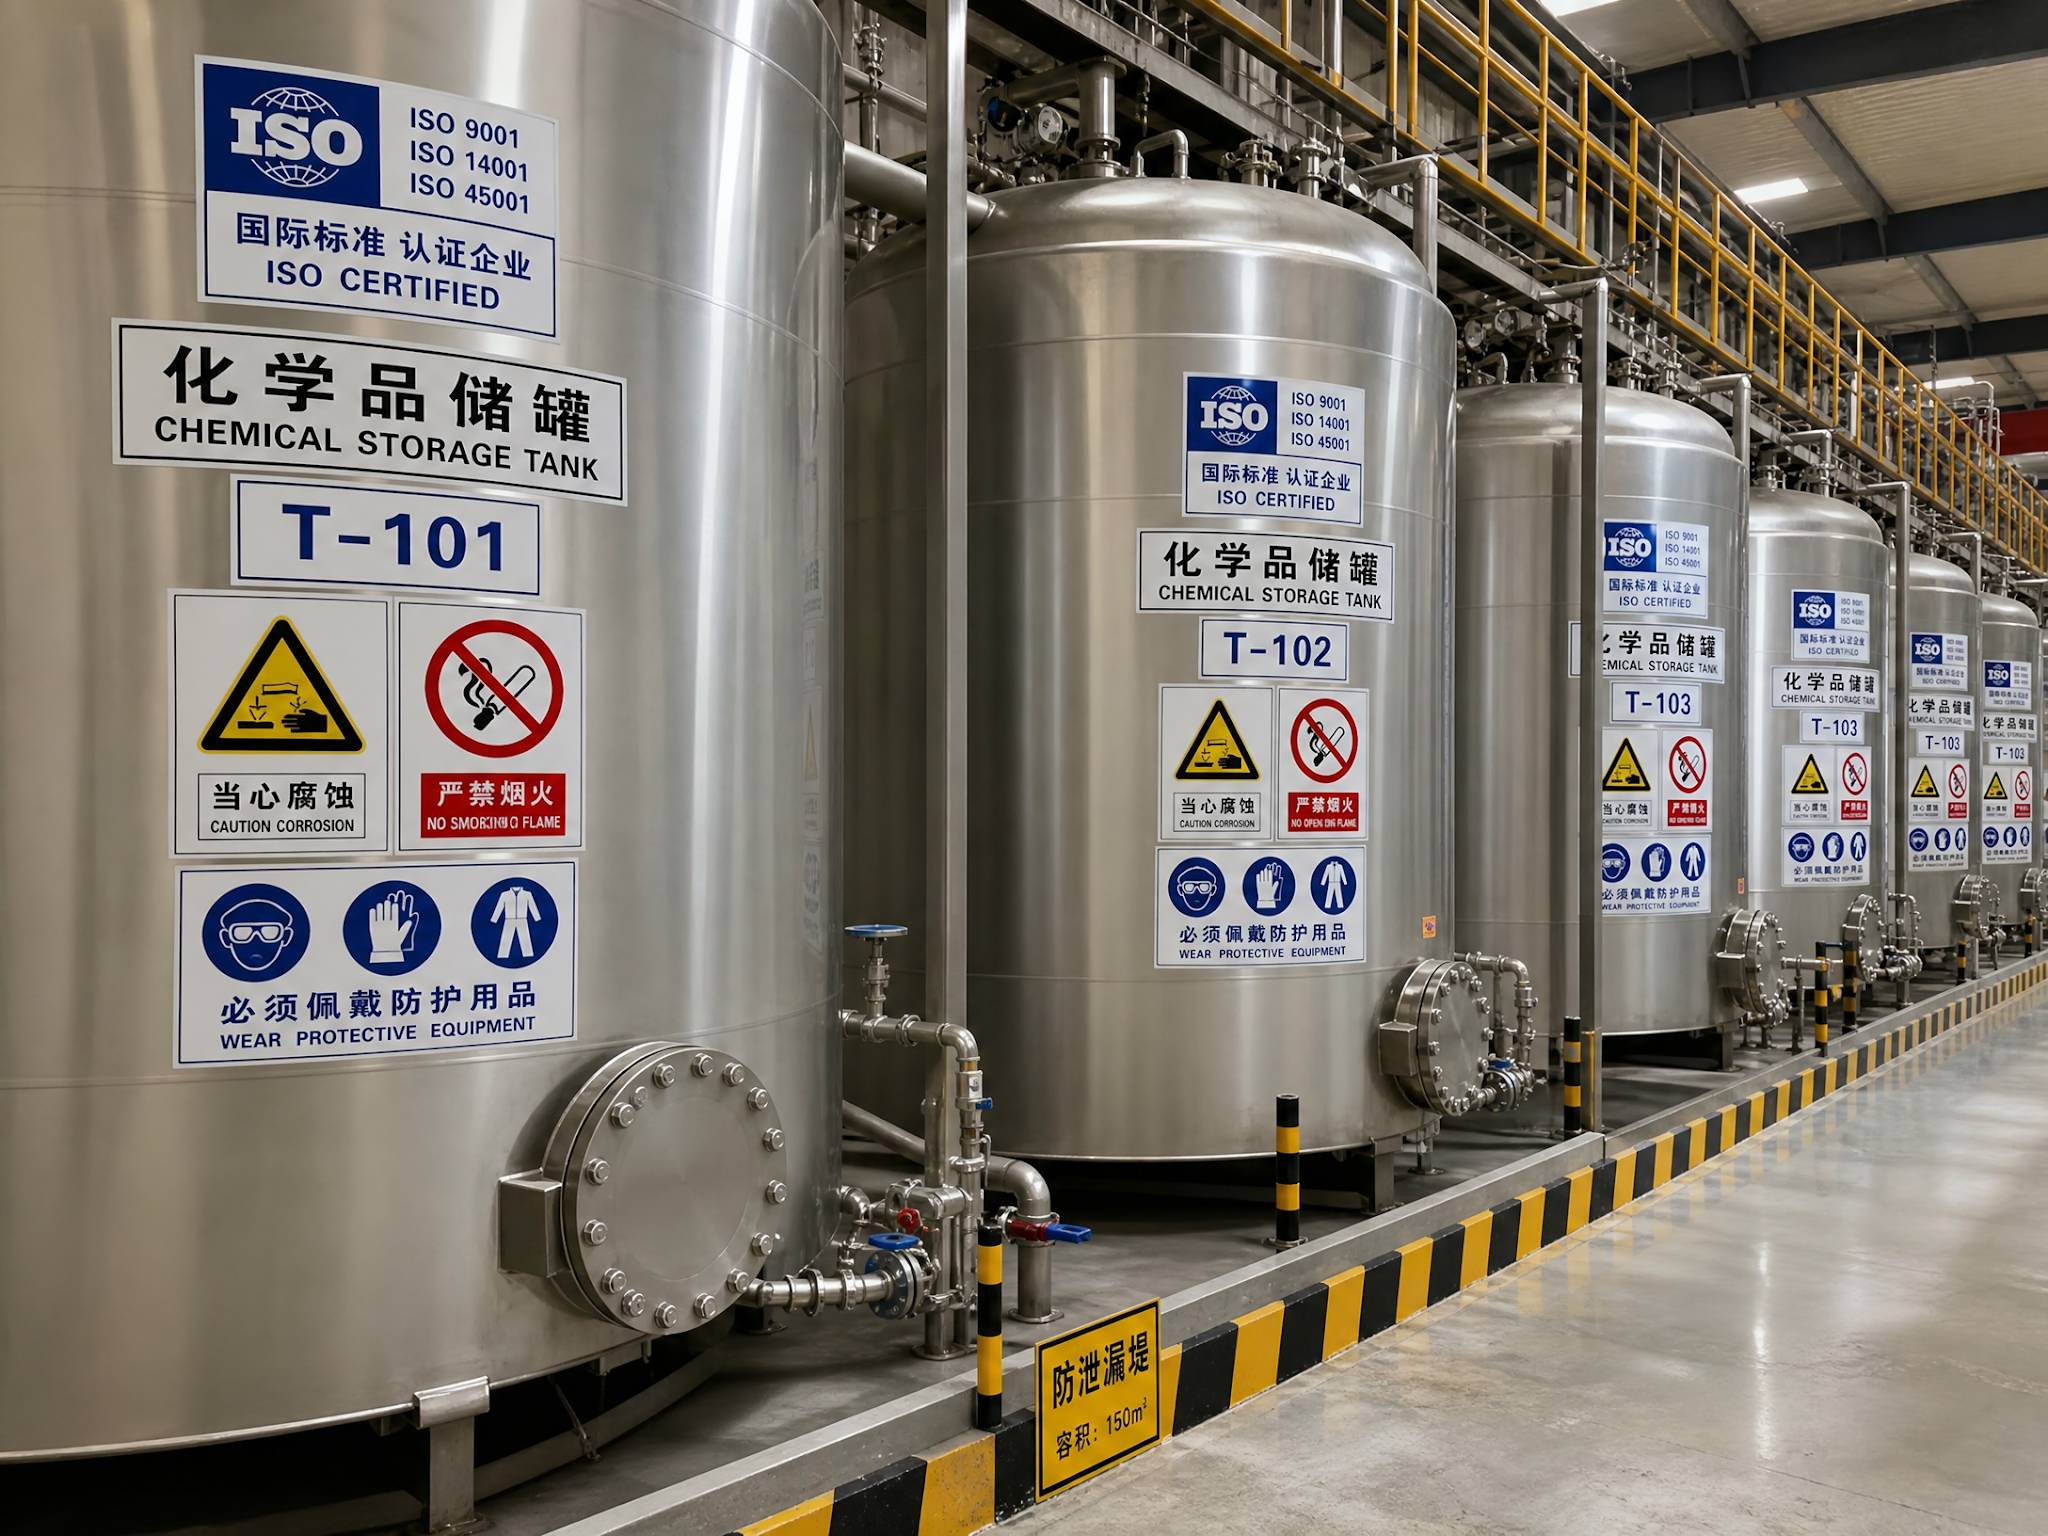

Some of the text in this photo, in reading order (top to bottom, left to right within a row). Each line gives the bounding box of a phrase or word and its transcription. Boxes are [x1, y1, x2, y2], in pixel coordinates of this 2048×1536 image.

[230, 107, 363, 167] ISO
[410, 107, 519, 149] ISO 9001
[410, 140, 529, 182] ISO 14001
[410, 173, 529, 214] ISO 45001
[236, 212, 532, 280] 国际标准 认证企业
[267, 260, 500, 310] ISO CERTIFIED
[163, 344, 591, 445] 化学品储罐
[1292, 392, 1346, 411] ISO 9001
[1200, 401, 1269, 432] ISO
[1291, 413, 1350, 431] ISO 14001
[154, 415, 599, 481] CHEMICAL STORAGE TANK
[1291, 432, 1350, 451] ISO 45001
[1202, 463, 1351, 492] 国际标准 认证企业
[1217, 490, 1335, 511] ISO CERTIFIED
[282, 503, 502, 572] T-101
[1665, 530, 1698, 542] ISO 9001
[1608, 537, 1652, 558] ISO
[1665, 544, 1679, 553] ISO
[1164, 541, 1379, 586] 化学品储罐
[1665, 557, 1679, 566] ISO
[1609, 578, 1658, 592] 国际标准
[1159, 585, 1382, 610] CHEMICAL STORAGE TANK
[1619, 596, 1691, 608] ISO CERTIFIED
[1799, 603, 1832, 619] ISO
[1223, 632, 1331, 667] T-102
[1915, 643, 1940, 656] ISO
[1603, 659, 1719, 674] EMICAL STORAGE TANK
[1987, 669, 2009, 680] ISO
[1625, 691, 1691, 715] T-103
[1781, 695, 1825, 703] CHEMICAL
[1812, 718, 1857, 736] T-103
[1926, 735, 1960, 750] T-103
[1996, 747, 2024, 760] T-103
[212, 781, 355, 811] 当心腐蚀
[437, 780, 553, 807] 严禁烟火
[1181, 797, 1255, 815] 当心腐蚀
[1296, 796, 1353, 813] 严禁烟火
[210, 819, 355, 834] CAUTION CORROSION
[427, 816, 446, 830] NO
[522, 815, 560, 829] FLAME
[1179, 819, 1255, 829] CAUTION CORROSION
[1291, 818, 1302, 828] NO
[1179, 923, 1346, 943] 必须佩戴防护用品
[1179, 946, 1346, 959] WEAR PROTECTIVE EQUIPMENT
[220, 980, 536, 1026] 必须佩戴防护用品
[220, 1016, 536, 1050] WEAR PROTECTIVE EQUIPMENT
[1053, 1330, 1149, 1410] 防泄漏堤
